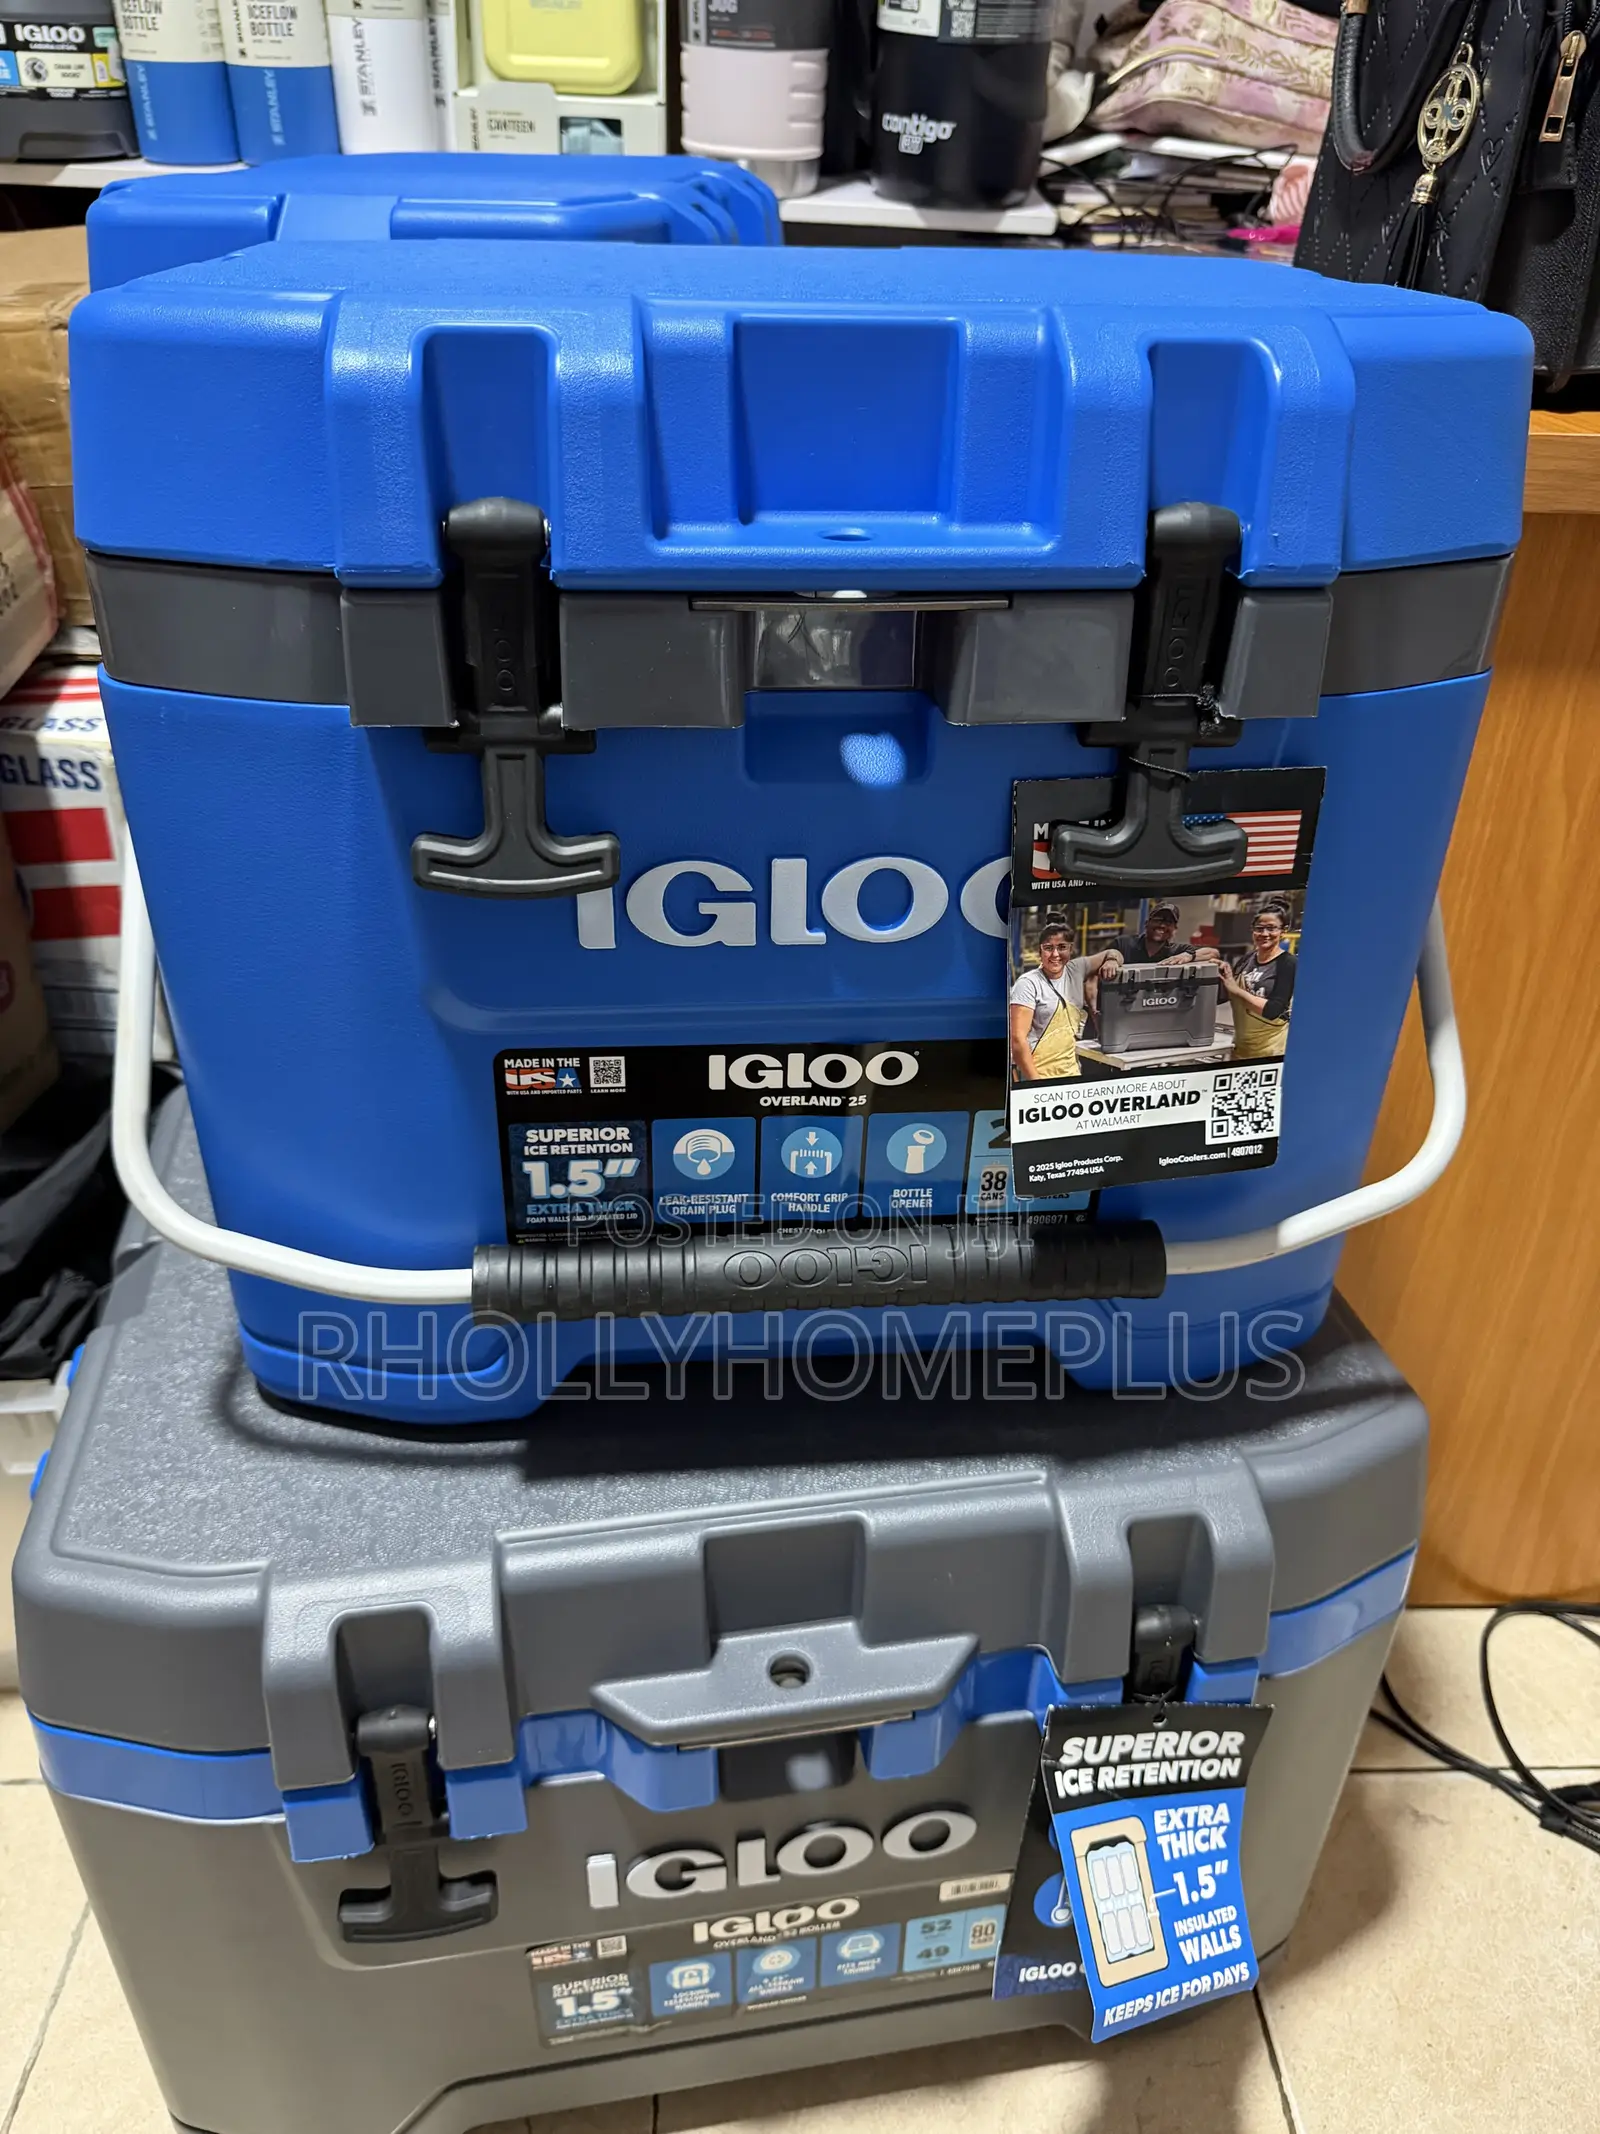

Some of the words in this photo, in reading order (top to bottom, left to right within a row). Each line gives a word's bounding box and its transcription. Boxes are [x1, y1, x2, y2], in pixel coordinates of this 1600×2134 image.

[247, 5, 298, 20] ICEFLOW
[14, 23, 86, 43] IGLOO
[123, 15, 160, 31] BOTTLE
[250, 22, 295, 37] BOTTLE
[352, 17, 373, 96] STANLEY
[428, 17, 444, 91] STANLEY
[136, 64, 155, 127] STANLEY
[264, 69, 284, 133] STANLEY
[882, 113, 957, 143] contigo
[0, 753, 102, 792] GLASS
[1031, 881, 1050, 890] WITH
[1051, 880, 1067, 889] USA
[1068, 879, 1084, 888] AND
[1142, 996, 1177, 1007] IGLOO
[504, 1058, 540, 1068] MADE
[542, 1058, 555, 1068] IN
[557, 1057, 580, 1067] THE
[709, 1051, 919, 1090] IGLOO
[505, 1067, 582, 1090] USA
[849, 1095, 867, 1107] 25
[1033, 1091, 1064, 1104] SCAN
[1065, 1090, 1081, 1100] TO
[1083, 1086, 1114, 1098] LEARN
[1116, 1083, 1148, 1095] MORE
[1149, 1079, 1187, 1091] ABOUT
[1018, 1104, 1083, 1125] IGLOO
[1089, 1090, 1201, 1116] OVERLAND
[1076, 1119, 1090, 1130] AT
[1091, 1114, 1142, 1129] WALMART
[526, 1127, 631, 1143] SUPERIOR
[524, 1144, 550, 1156] ICE
[551, 1142, 633, 1155] RETENTION
[1158, 1151, 1226, 1166] IglooCoolers.com
[1231, 1144, 1263, 1158] 4907012
[1036, 1162, 1055, 1172] 2025
[1055, 1159, 1072, 1171] Igloo
[1073, 1156, 1103, 1168] Products
[1104, 1154, 1123, 1166] Corp.
[981, 1171, 1007, 1191] 38
[1029, 1173, 1047, 1184] Katy,
[1047, 1171, 1066, 1181] Texas
[1066, 1168, 1089, 1178] 77494
[1090, 1166, 1104, 1175] USA
[660, 1193, 749, 1205] LEAK-RESISTANT
[770, 1192, 821, 1203] COMFORT
[823, 1193, 848, 1203] GRIP
[891, 1198, 933, 1209] OPENER
[893, 1188, 933, 1199] BOTTLE
[980, 1192, 1005, 1201] CANS
[526, 1202, 582, 1216] EXTRA
[672, 1206, 706, 1216] DRAIN
[708, 1204, 736, 1214] PLUG
[788, 1203, 830, 1213] HANDLE
[1027, 1214, 1068, 1225] 4906971
[723, 1244, 928, 1290] IGLOO
[1059, 1730, 1246, 1766] SUPERIOR
[1054, 1767, 1094, 1799] ICE
[1095, 1757, 1243, 1791] RETENTION
[1153, 1802, 1231, 1835] EXTRA
[1156, 1825, 1228, 1862] THICK
[586, 1809, 978, 1909] IGLOO
[693, 1898, 860, 1943] IGLOO
[921, 1919, 952, 1934] 52
[971, 1922, 995, 1938] 80
[1173, 1905, 1238, 1938] INSULATED
[1178, 1926, 1243, 1966] WALLS
[1019, 1962, 1078, 1983] IGLOO
[1103, 1995, 1154, 2028] KEEPS
[1154, 1986, 1180, 2011] ICE
[1181, 1978, 1212, 2004] FOR
[1213, 1962, 1250, 1991] DAYS
